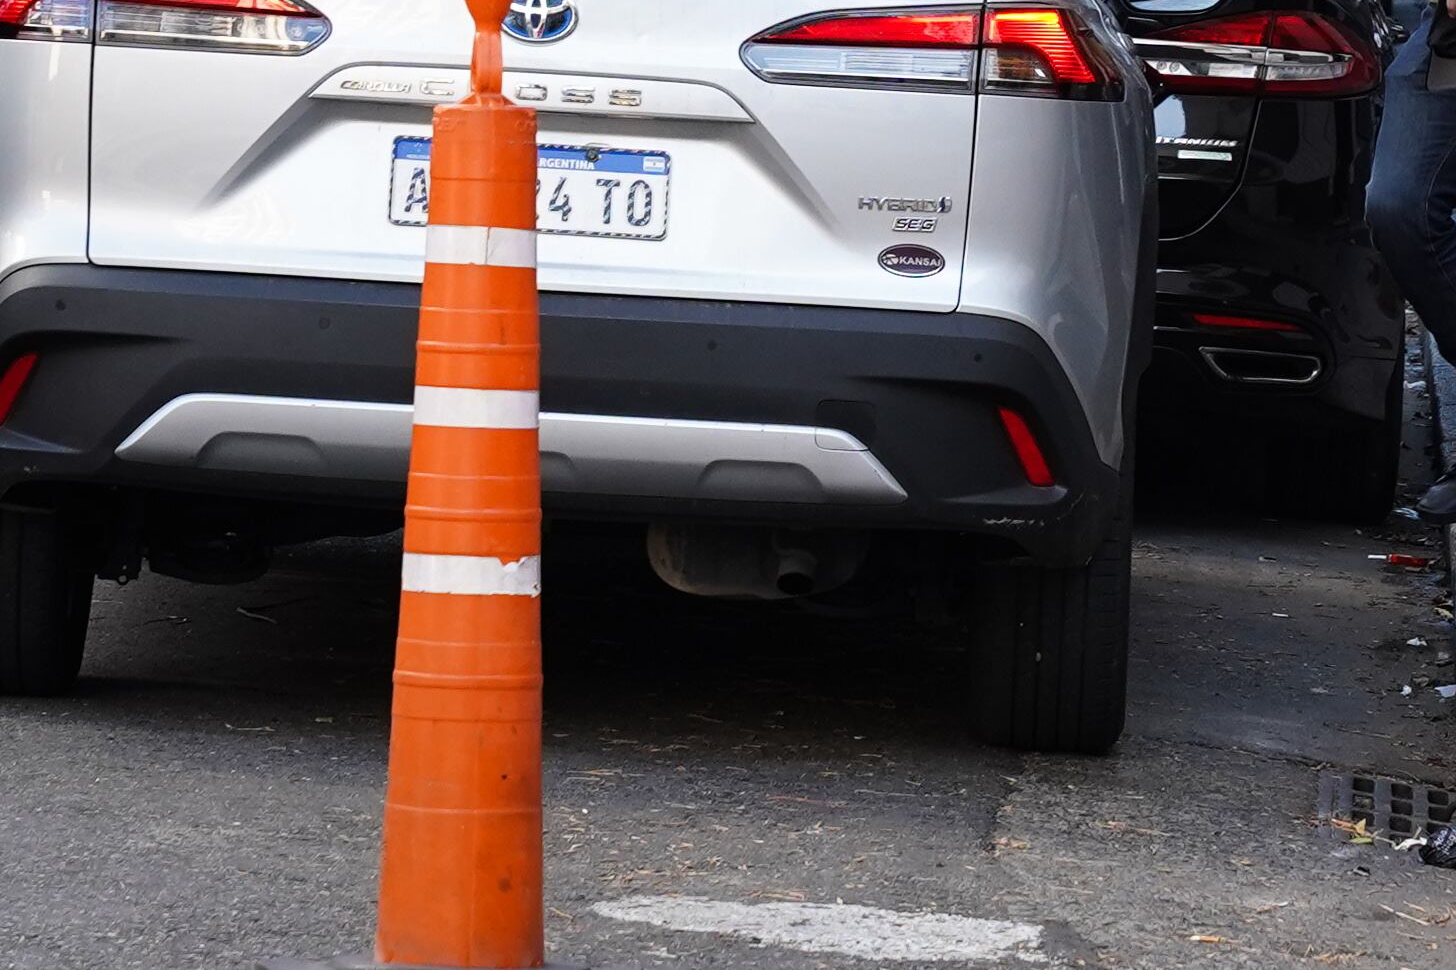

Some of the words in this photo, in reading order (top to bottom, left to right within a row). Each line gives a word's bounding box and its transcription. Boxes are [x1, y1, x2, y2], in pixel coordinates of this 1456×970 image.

[420, 78, 643, 107] COSS
[538, 157, 596, 170] RGENTINA
[858, 196, 938, 212] HYBRID
[894, 218, 935, 230] SEG
[899, 256, 941, 267] KANSAI
